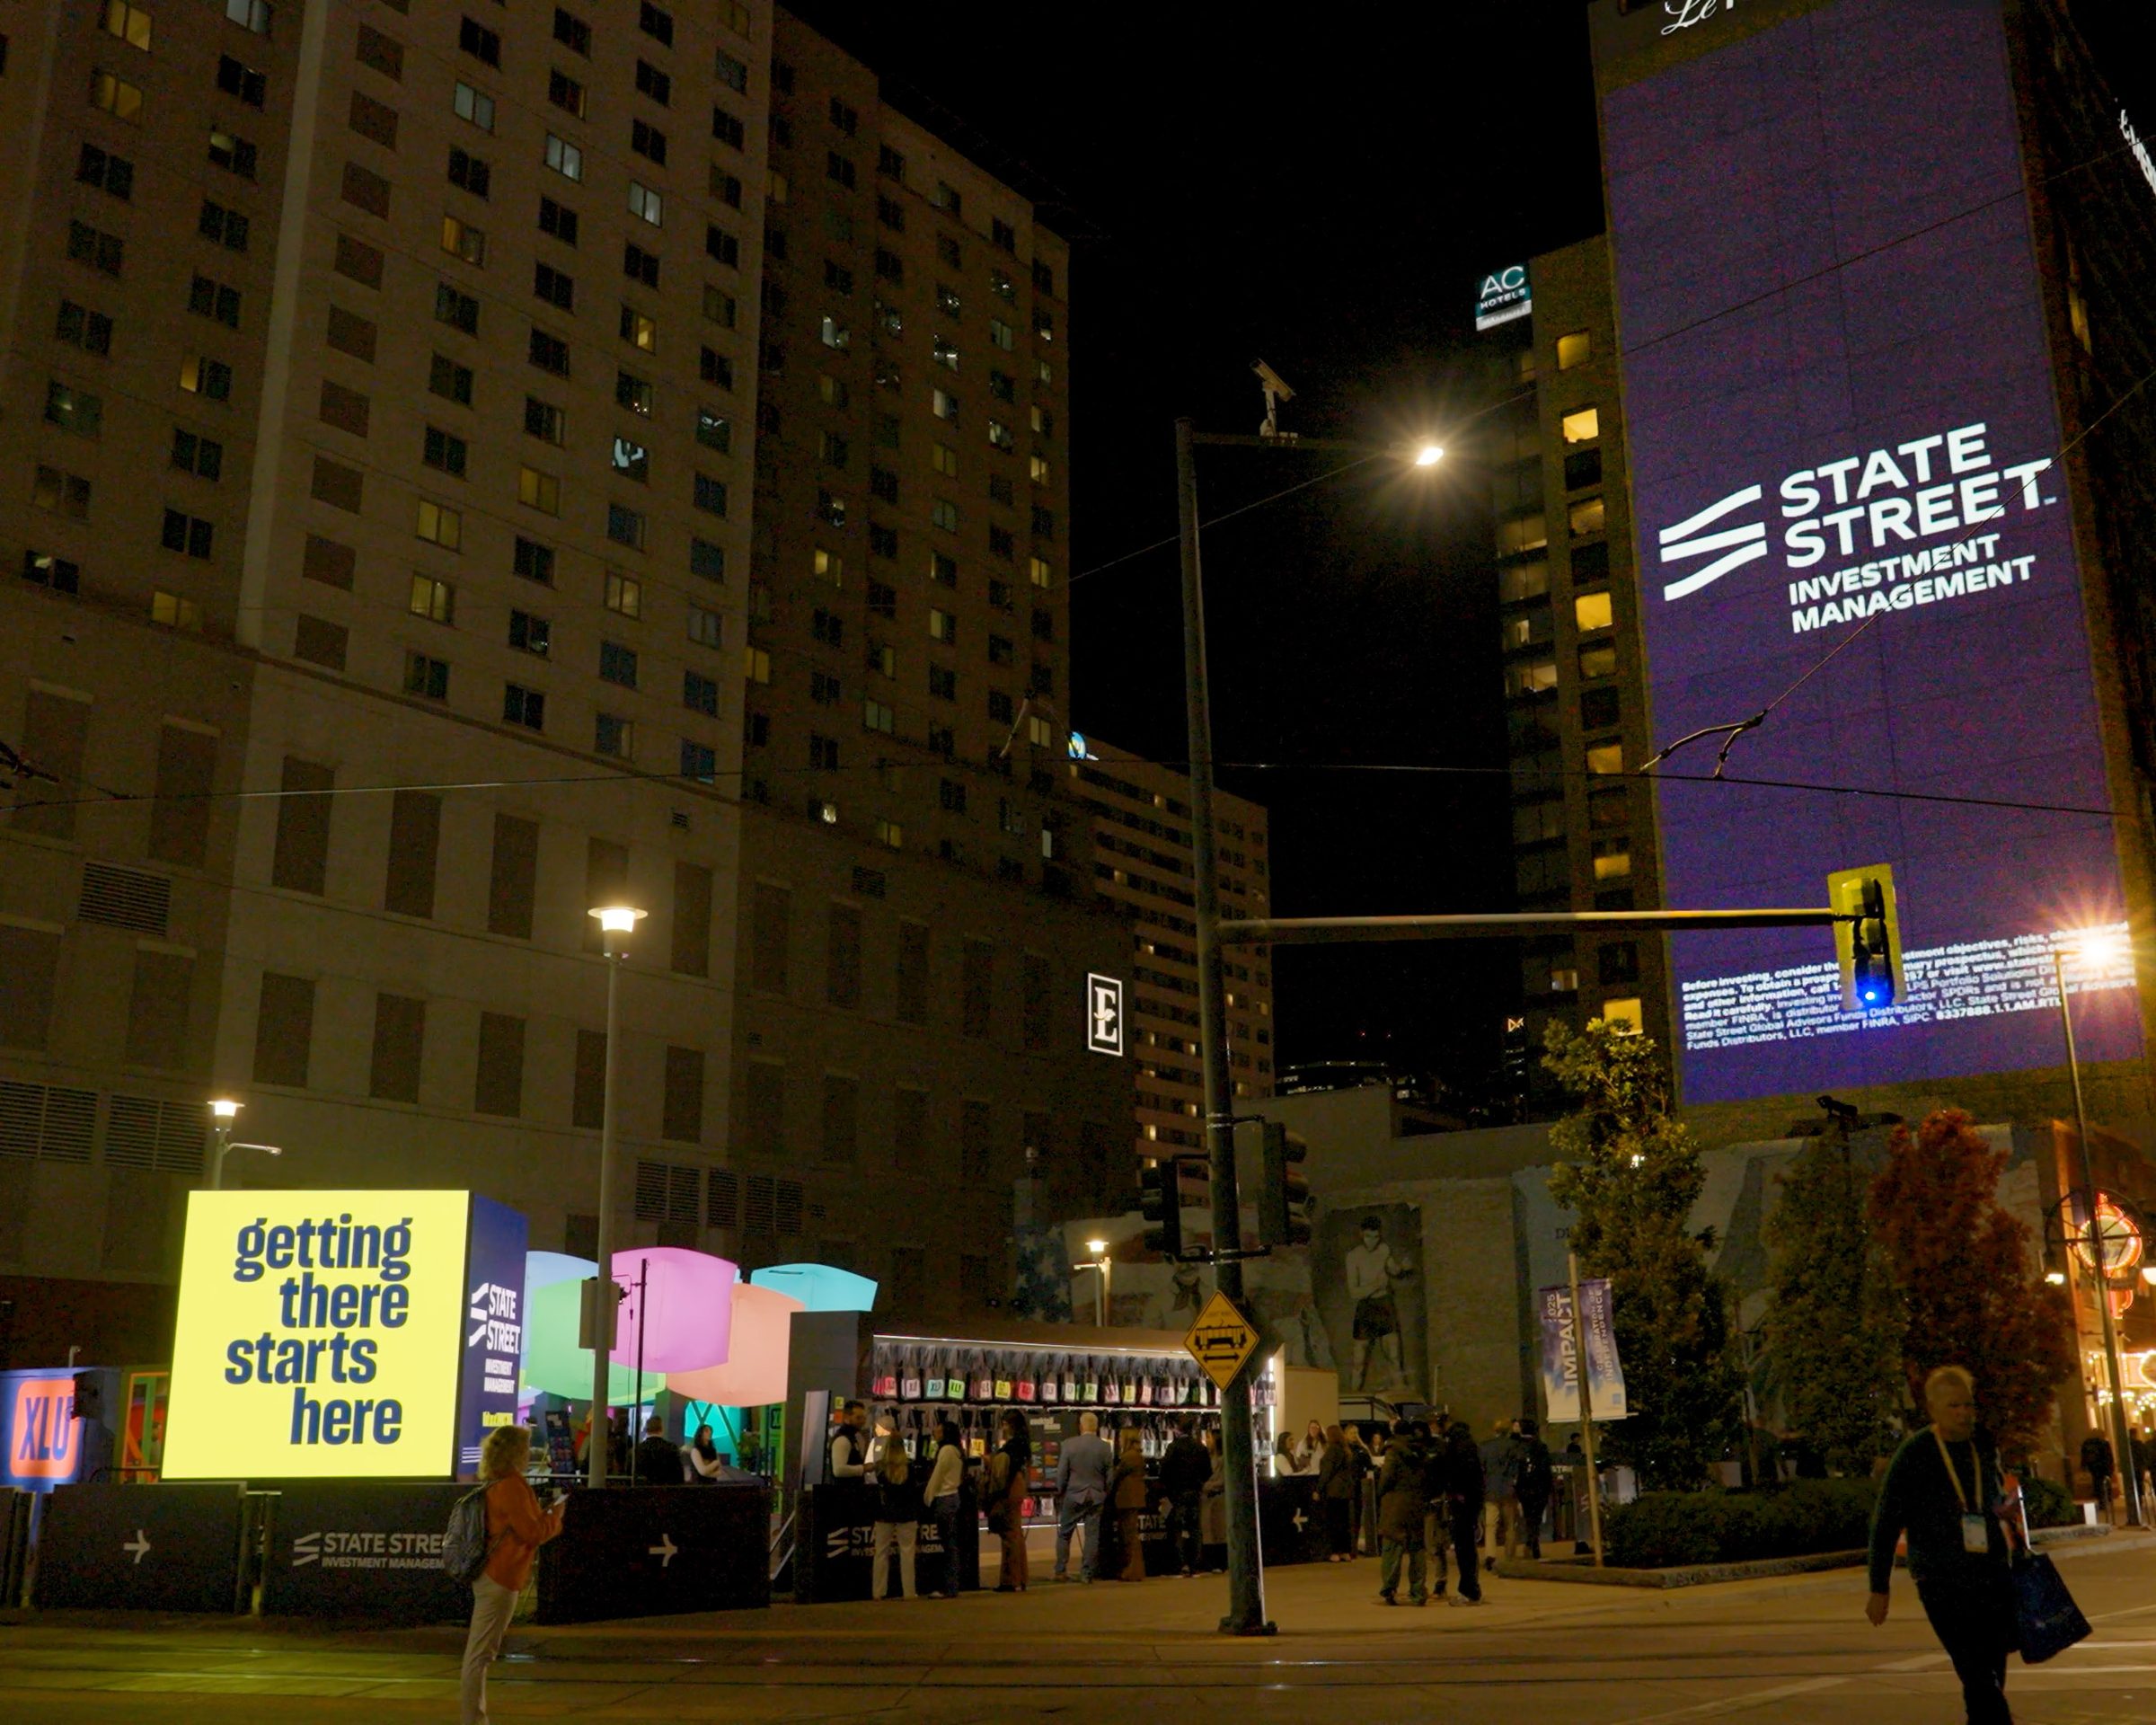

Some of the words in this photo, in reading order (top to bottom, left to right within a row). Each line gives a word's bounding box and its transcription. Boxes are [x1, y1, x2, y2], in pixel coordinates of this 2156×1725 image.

[1480, 265, 1525, 299] AC
[1480, 288, 1525, 309] HOTELS
[1779, 422, 1993, 518] STATE
[1789, 533, 2001, 606] INVESTMENT
[1792, 555, 2036, 633] MANAGEMENT
[1682, 978, 1718, 991] Before
[1774, 965, 1822, 979] consider
[1740, 984, 1754, 994] To
[1755, 978, 1791, 992] obtain
[1802, 972, 1840, 986] prospe
[1903, 960, 1933, 973] mary
[1906, 982, 1929, 993] LPS
[1931, 975, 1980, 990] Portfolio
[1683, 1000, 1704, 1010] and
[1686, 1029, 1712, 1039] State
[1716, 1025, 1746, 1036] Street
[1749, 1021, 1783, 1032] Global
[1786, 1014, 1832, 1028] Advisors
[1833, 1010, 1867, 1022] Funds
[1967, 995, 1998, 1006] State
[2000, 989, 2037, 1002] Street
[2038, 985, 2077, 997] Gloal
[1785, 1004, 1839, 1018] distributor
[1907, 991, 1937, 1003] ector
[1687, 1039, 1719, 1049] Funds
[1816, 1022, 1859, 1034] member
[234, 1213, 413, 1282] getting
[279, 1271, 410, 1329] there
[489, 1284, 517, 1320] STATE
[1556, 1290, 1578, 1387] IMPACT
[225, 1331, 378, 1384] starts
[18, 1395, 75, 1461] XLU
[290, 1386, 402, 1445] here
[324, 1532, 385, 1553] STATE
[389, 1533, 443, 1554] STRE
[322, 1556, 387, 1568] INVESTMENT
[389, 1557, 446, 1569] MANAGEM
